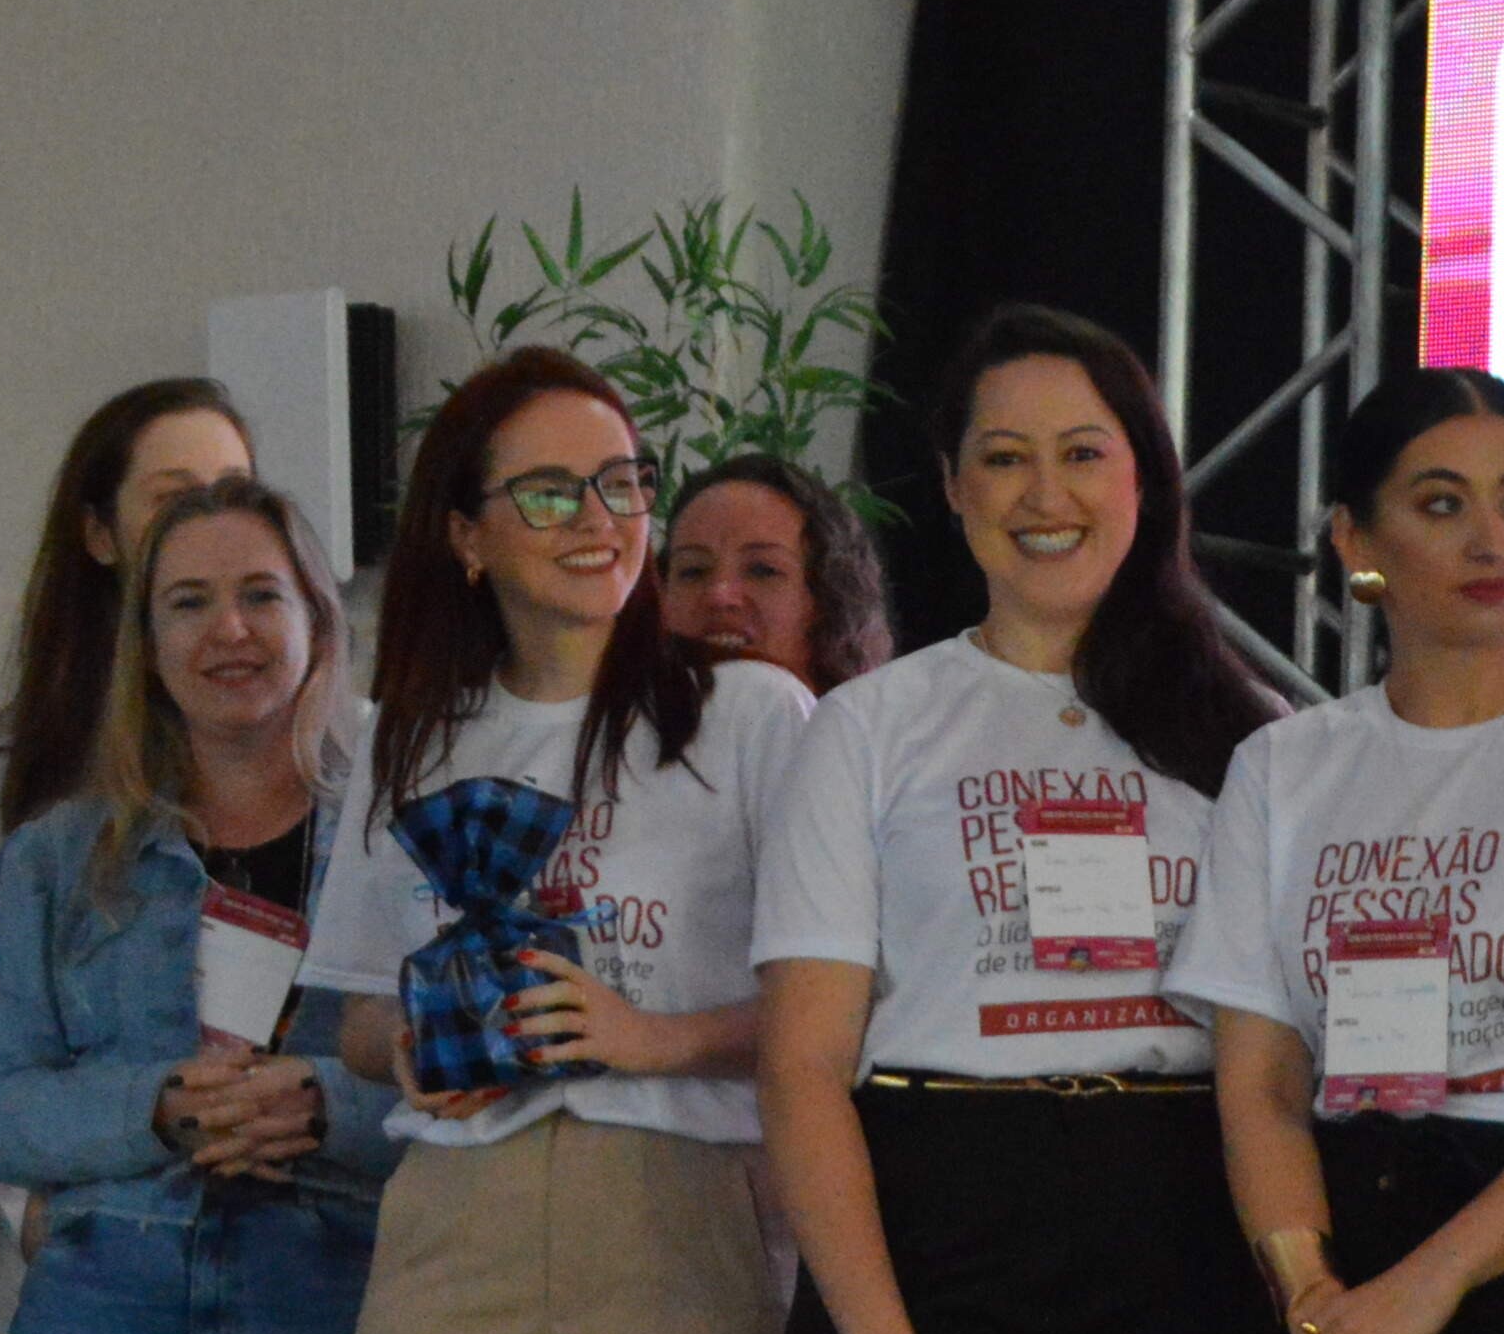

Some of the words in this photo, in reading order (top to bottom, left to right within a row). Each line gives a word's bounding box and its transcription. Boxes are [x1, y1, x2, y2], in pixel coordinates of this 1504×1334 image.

[957, 766, 1148, 812] CONEXÃO
[1314, 826, 1501, 890] CONEXÃO
[1302, 879, 1482, 944] PESSOAS
[975, 950, 1007, 976] de
